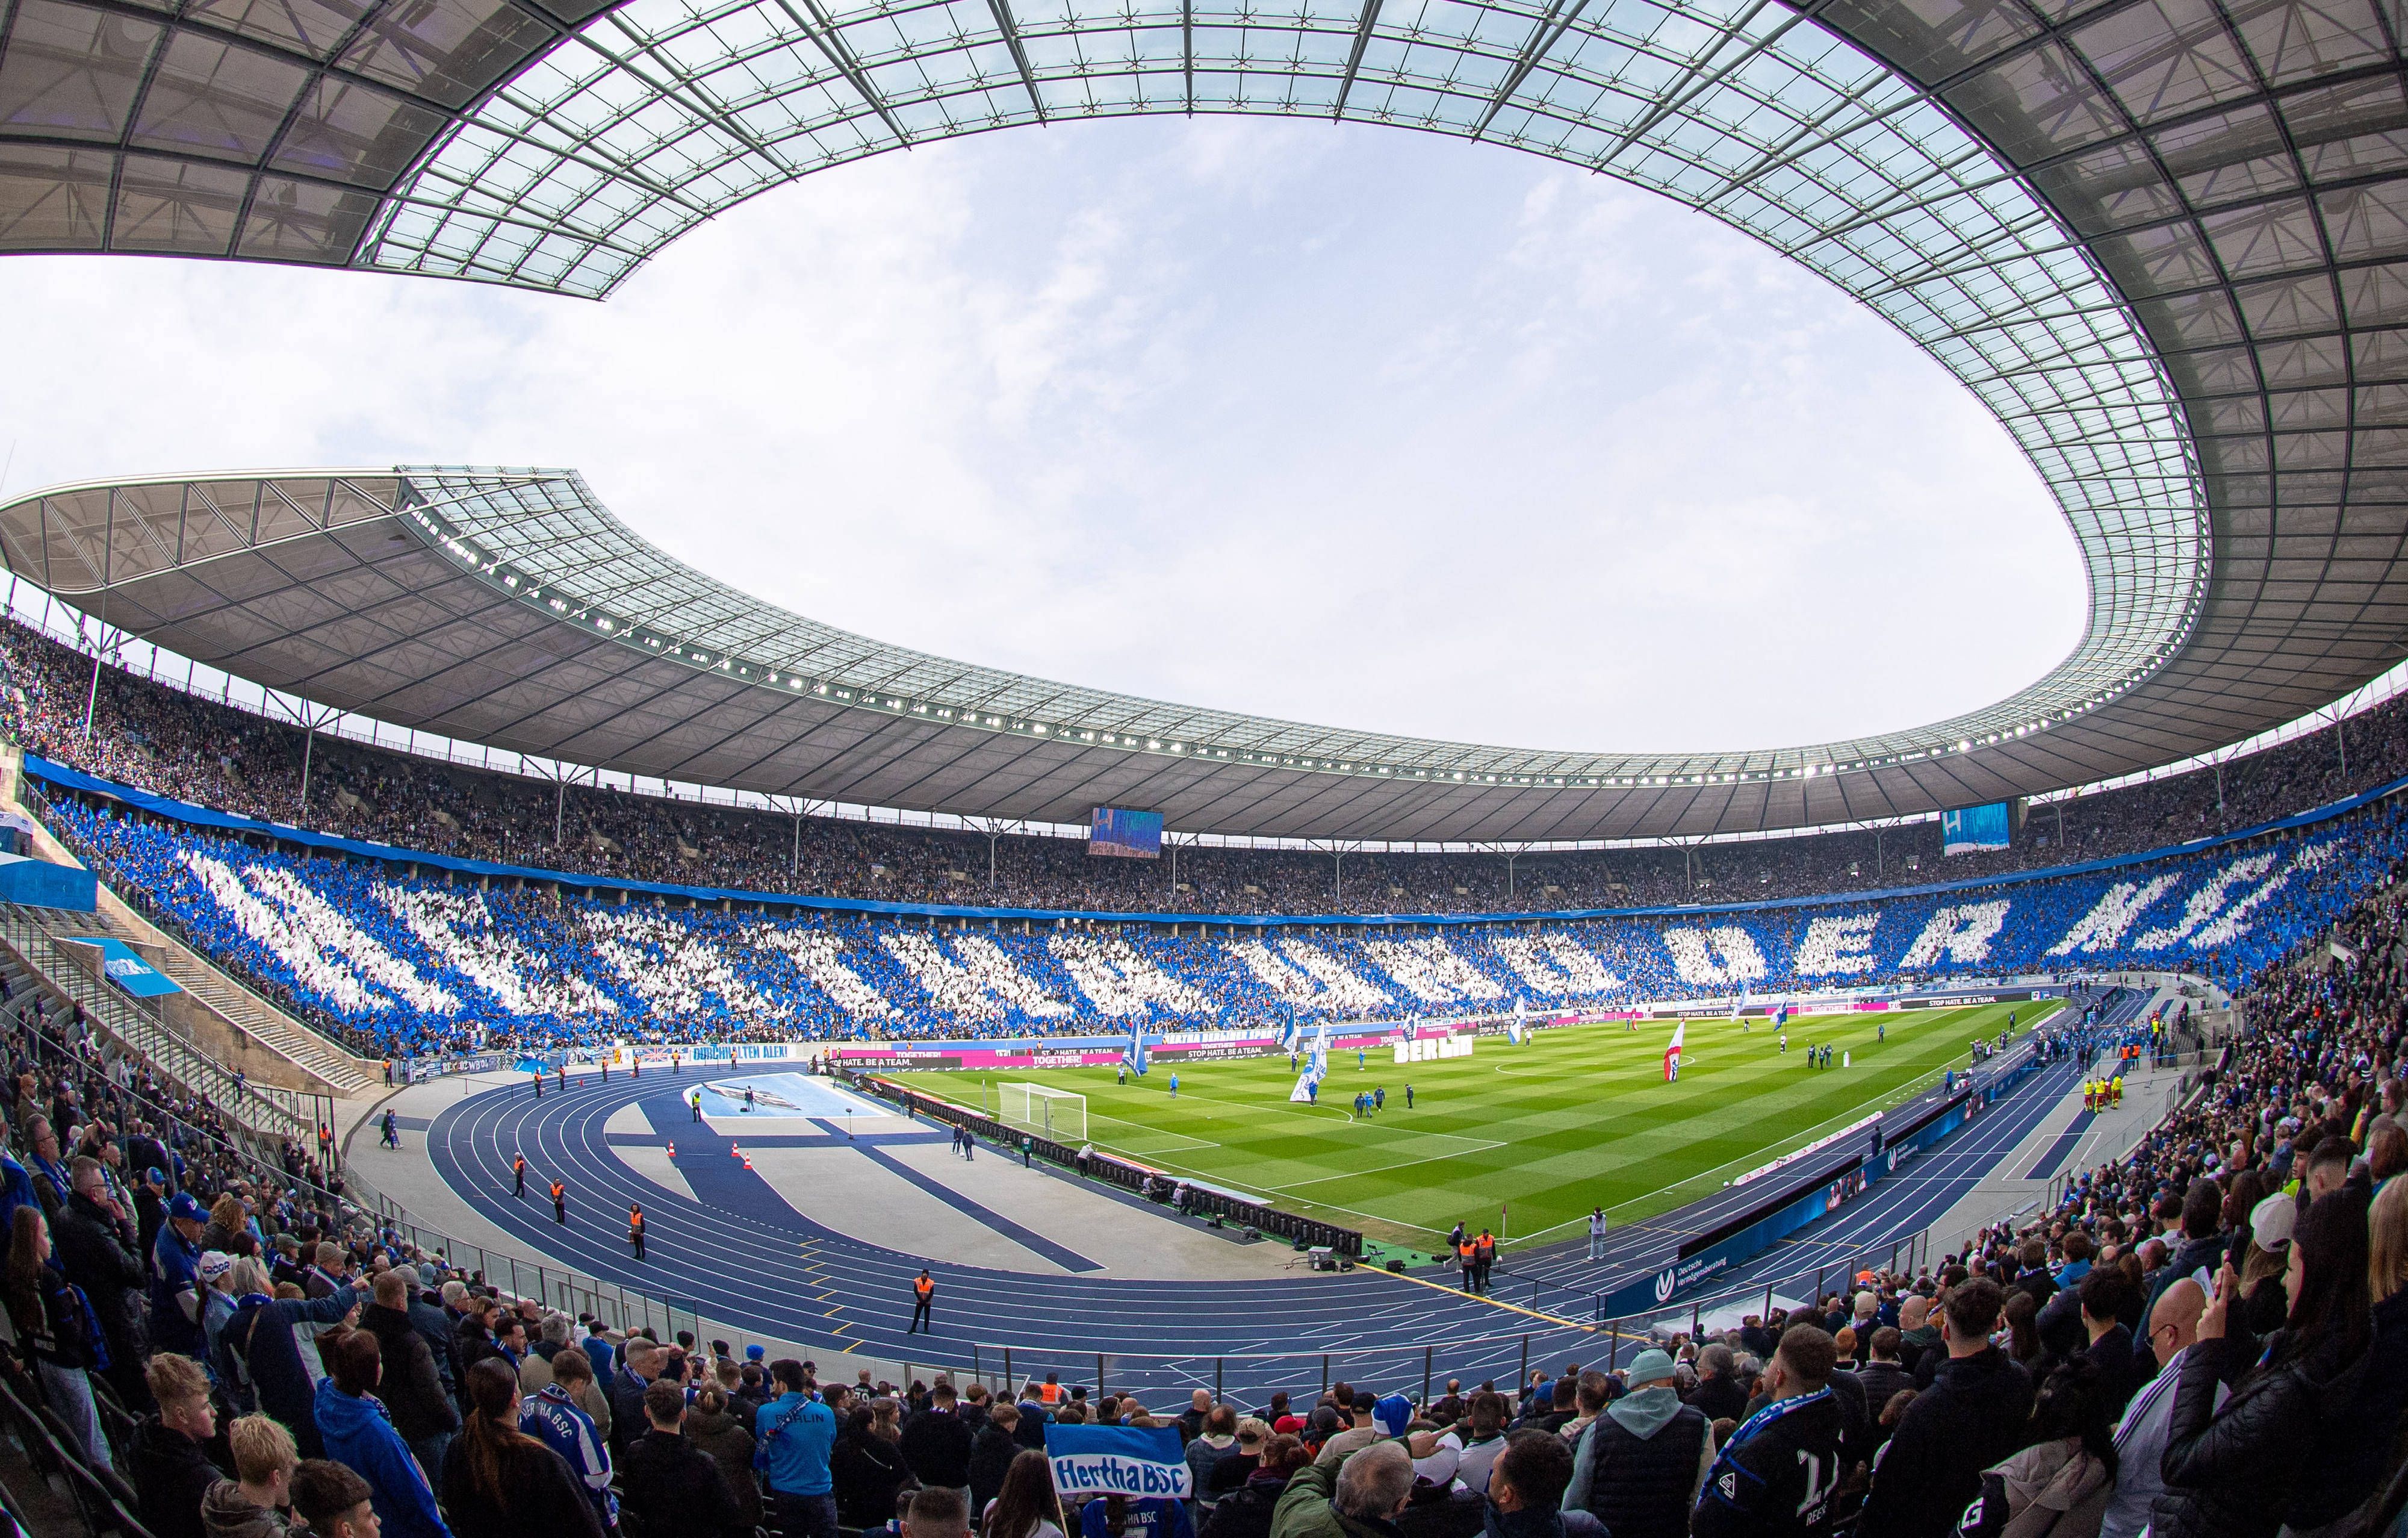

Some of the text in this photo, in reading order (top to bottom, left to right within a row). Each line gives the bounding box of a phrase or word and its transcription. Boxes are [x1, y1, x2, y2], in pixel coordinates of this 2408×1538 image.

[1663, 899, 2011, 985] DER
[693, 1044, 760, 1060] DURCHHLTEN
[763, 1045, 788, 1058] ALEX!
[1188, 1048, 1206, 1057] STOP
[1207, 1048, 1227, 1057] HATE.
[1243, 1046, 1263, 1054] TEAM.
[885, 1057, 913, 1066] TEAM.
[1033, 1055, 1082, 1065] TOGETHER!
[1677, 1256, 1727, 1287] Vermögensberatung
[1678, 1259, 1703, 1276] Deutsche
[521, 1402, 573, 1438] HERHA BSC
[775, 1413, 824, 1424] BRLIN
[1140, 1511, 1156, 1524] BSC
